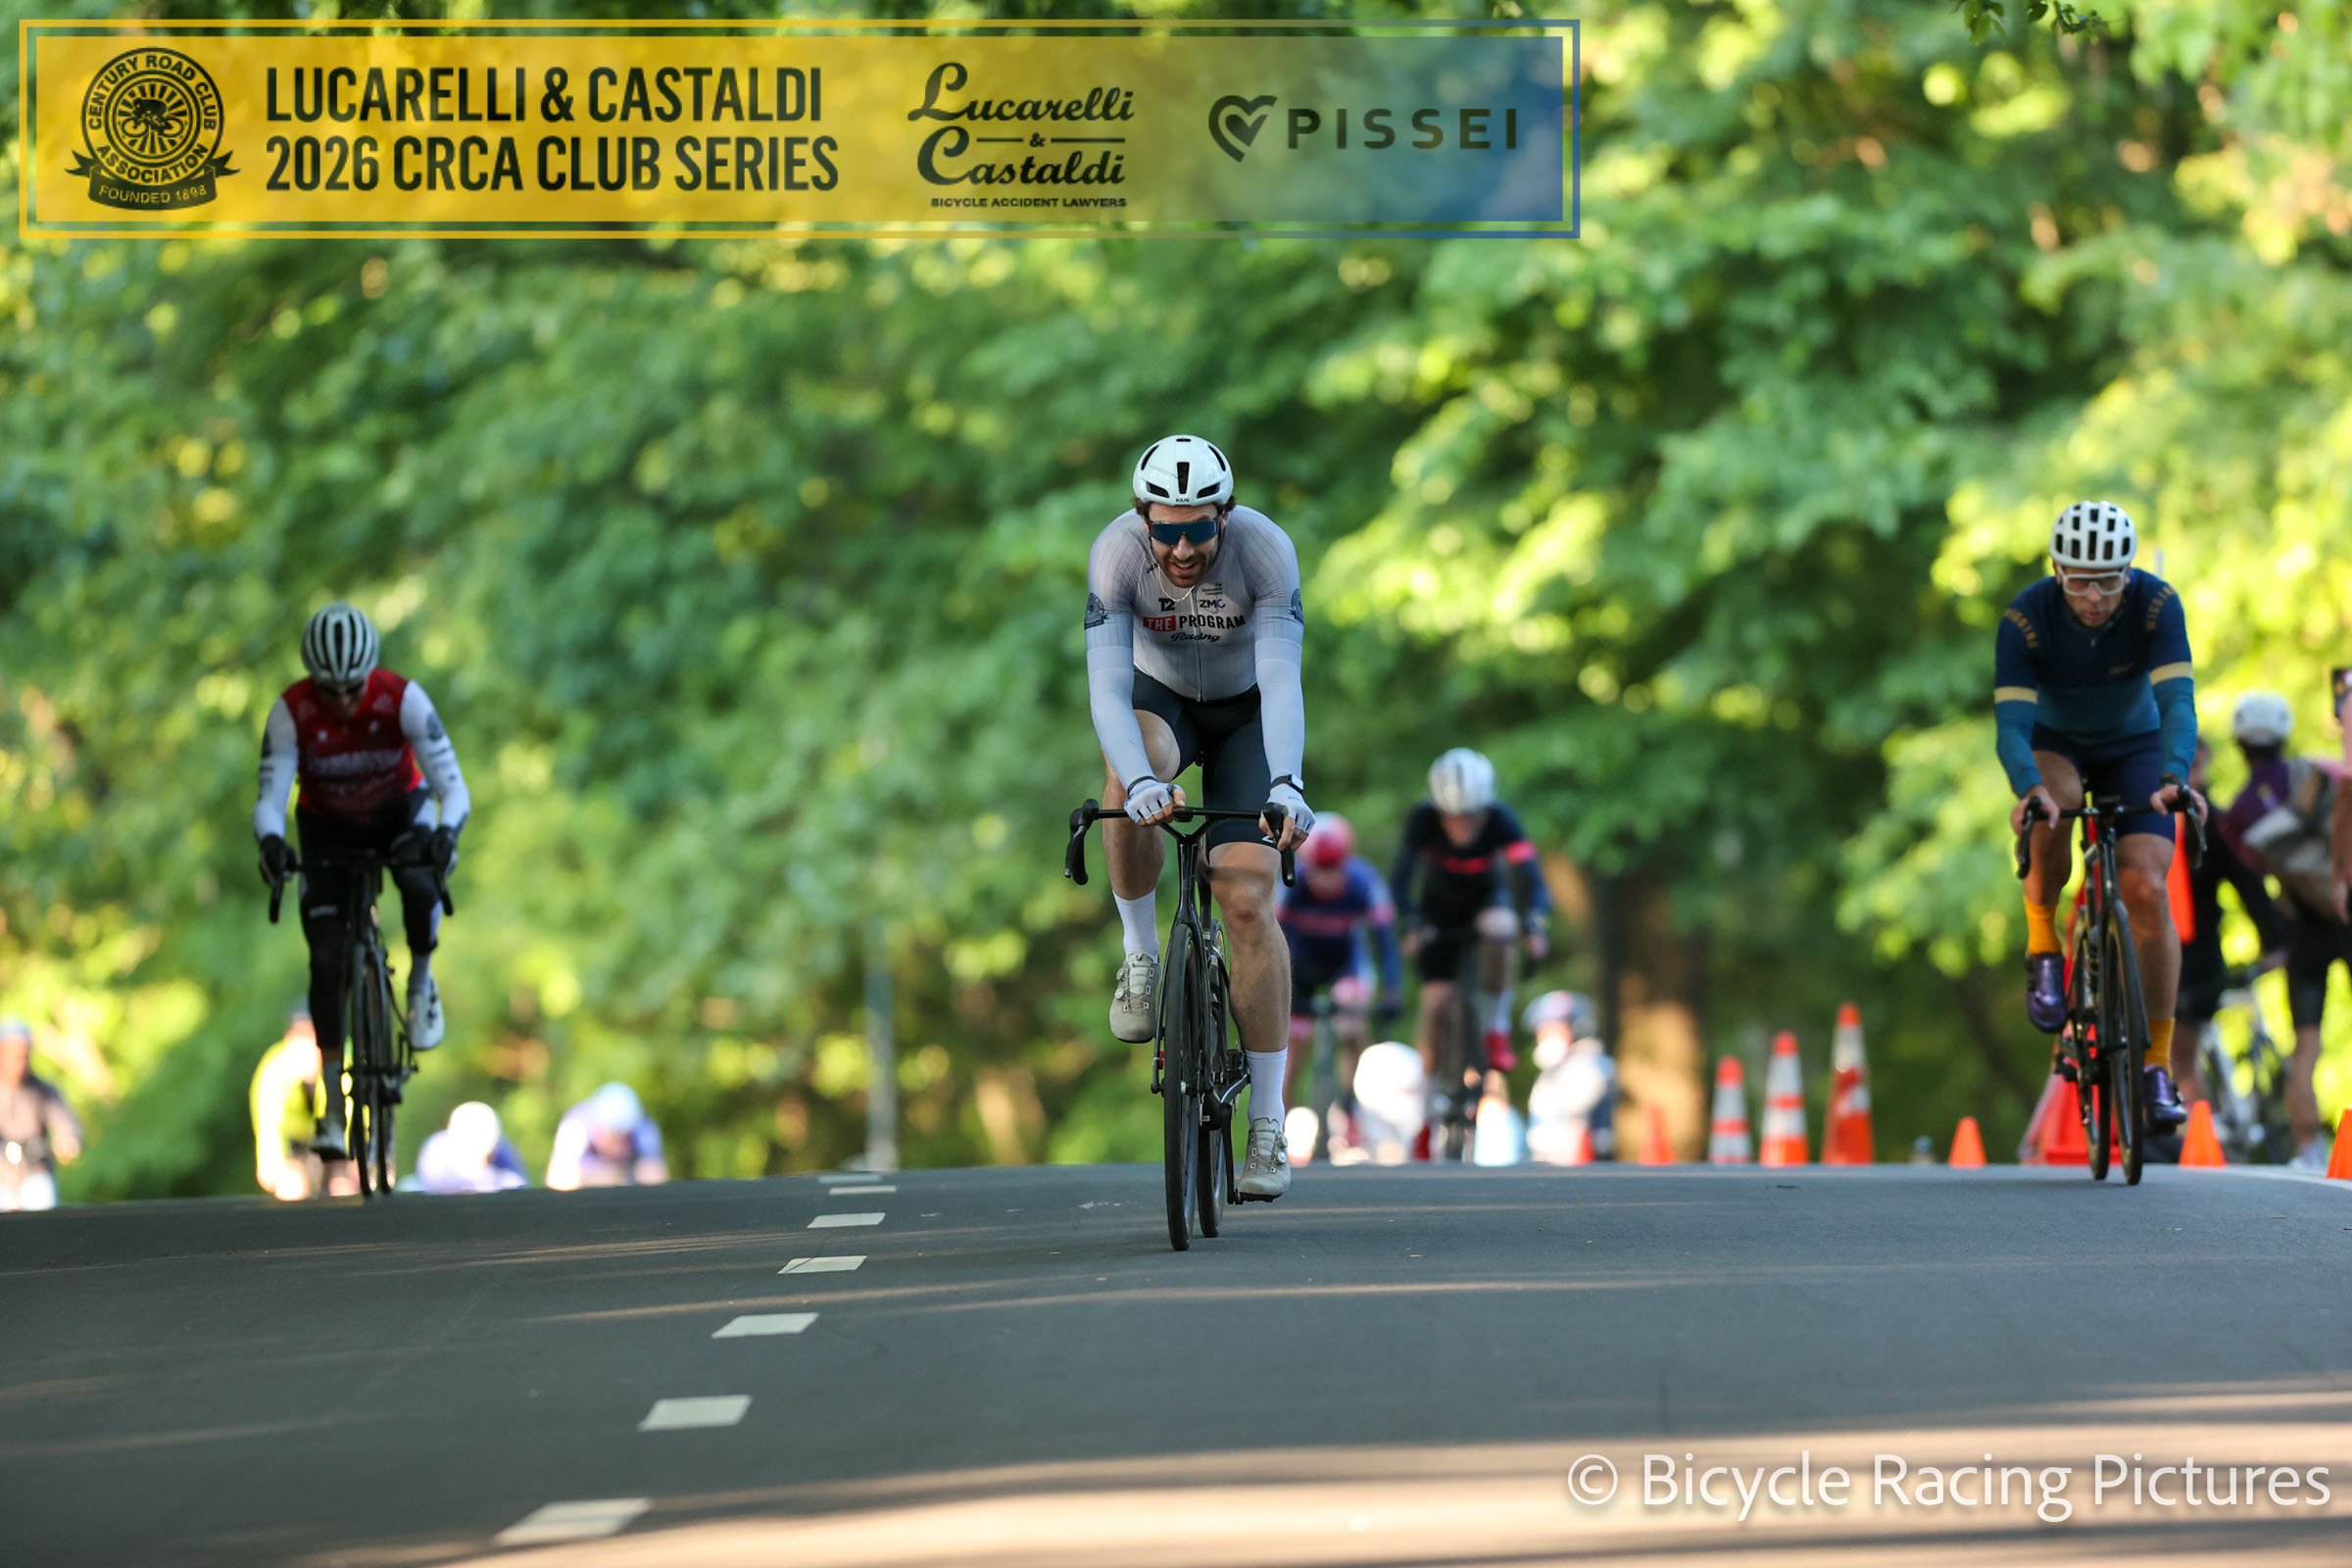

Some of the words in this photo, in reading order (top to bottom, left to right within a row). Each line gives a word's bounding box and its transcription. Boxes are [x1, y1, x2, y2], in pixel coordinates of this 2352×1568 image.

[1147, 617, 1173, 631] THE
[1179, 614, 1246, 629] PROGRAM
[1170, 632, 1221, 642] Racing
